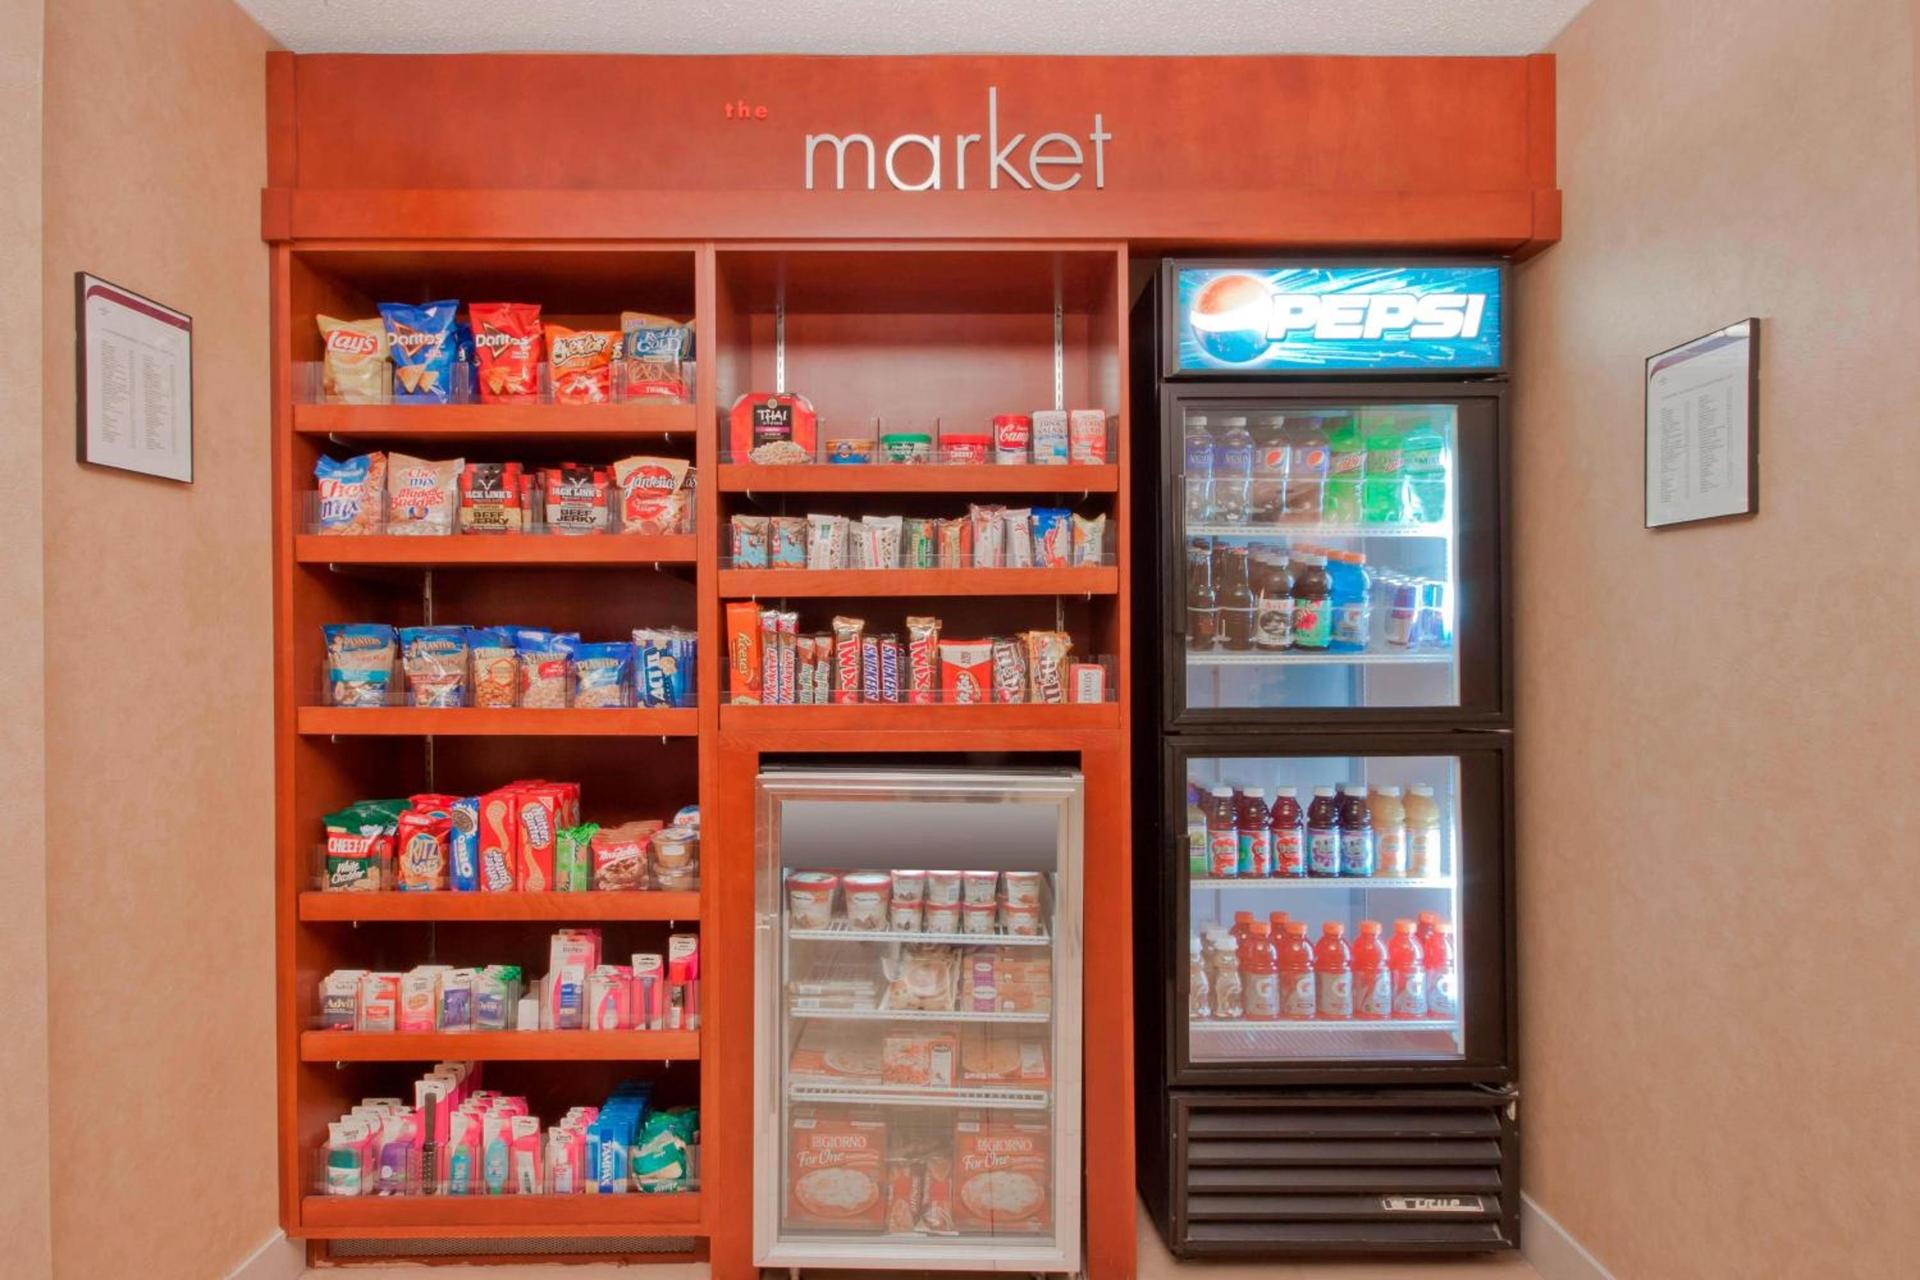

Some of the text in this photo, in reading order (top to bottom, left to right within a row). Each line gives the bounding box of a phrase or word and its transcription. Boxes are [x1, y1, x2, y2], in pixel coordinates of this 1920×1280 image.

[724, 100, 769, 119] the
[805, 86, 1113, 192] market
[1265, 293, 1487, 341] PEPSI
[327, 331, 376, 353] Lay's
[387, 332, 446, 348] Doritos
[475, 333, 530, 348] Doritos
[637, 338, 683, 353] GOLD
[757, 409, 788, 424] THAI
[319, 479, 365, 500] Chex
[465, 490, 513, 499] JACK LINK'S
[552, 487, 602, 497] JACK LINK'S
[557, 514, 597, 523] JERKY
[560, 508, 593, 516] BEEF
[470, 517, 509, 525] JERKY
[837, 633, 859, 690] TWIX
[909, 640, 931, 691] TWIX
[863, 643, 880, 702] SNICKERS
[881, 643, 898, 704] SNICKERS
[410, 838, 439, 864] RITZ
[458, 834, 473, 878] OREO
[337, 860, 360, 873] White
[331, 870, 366, 884] Cheddar
[327, 998, 354, 1009] Advil
[811, 1136, 867, 1148] DIGIORNO
[977, 1139, 1033, 1152] DIGIORNO
[601, 1140, 613, 1186] TAMPAX
[796, 1149, 846, 1167] For One
[962, 1151, 1010, 1170] For One
